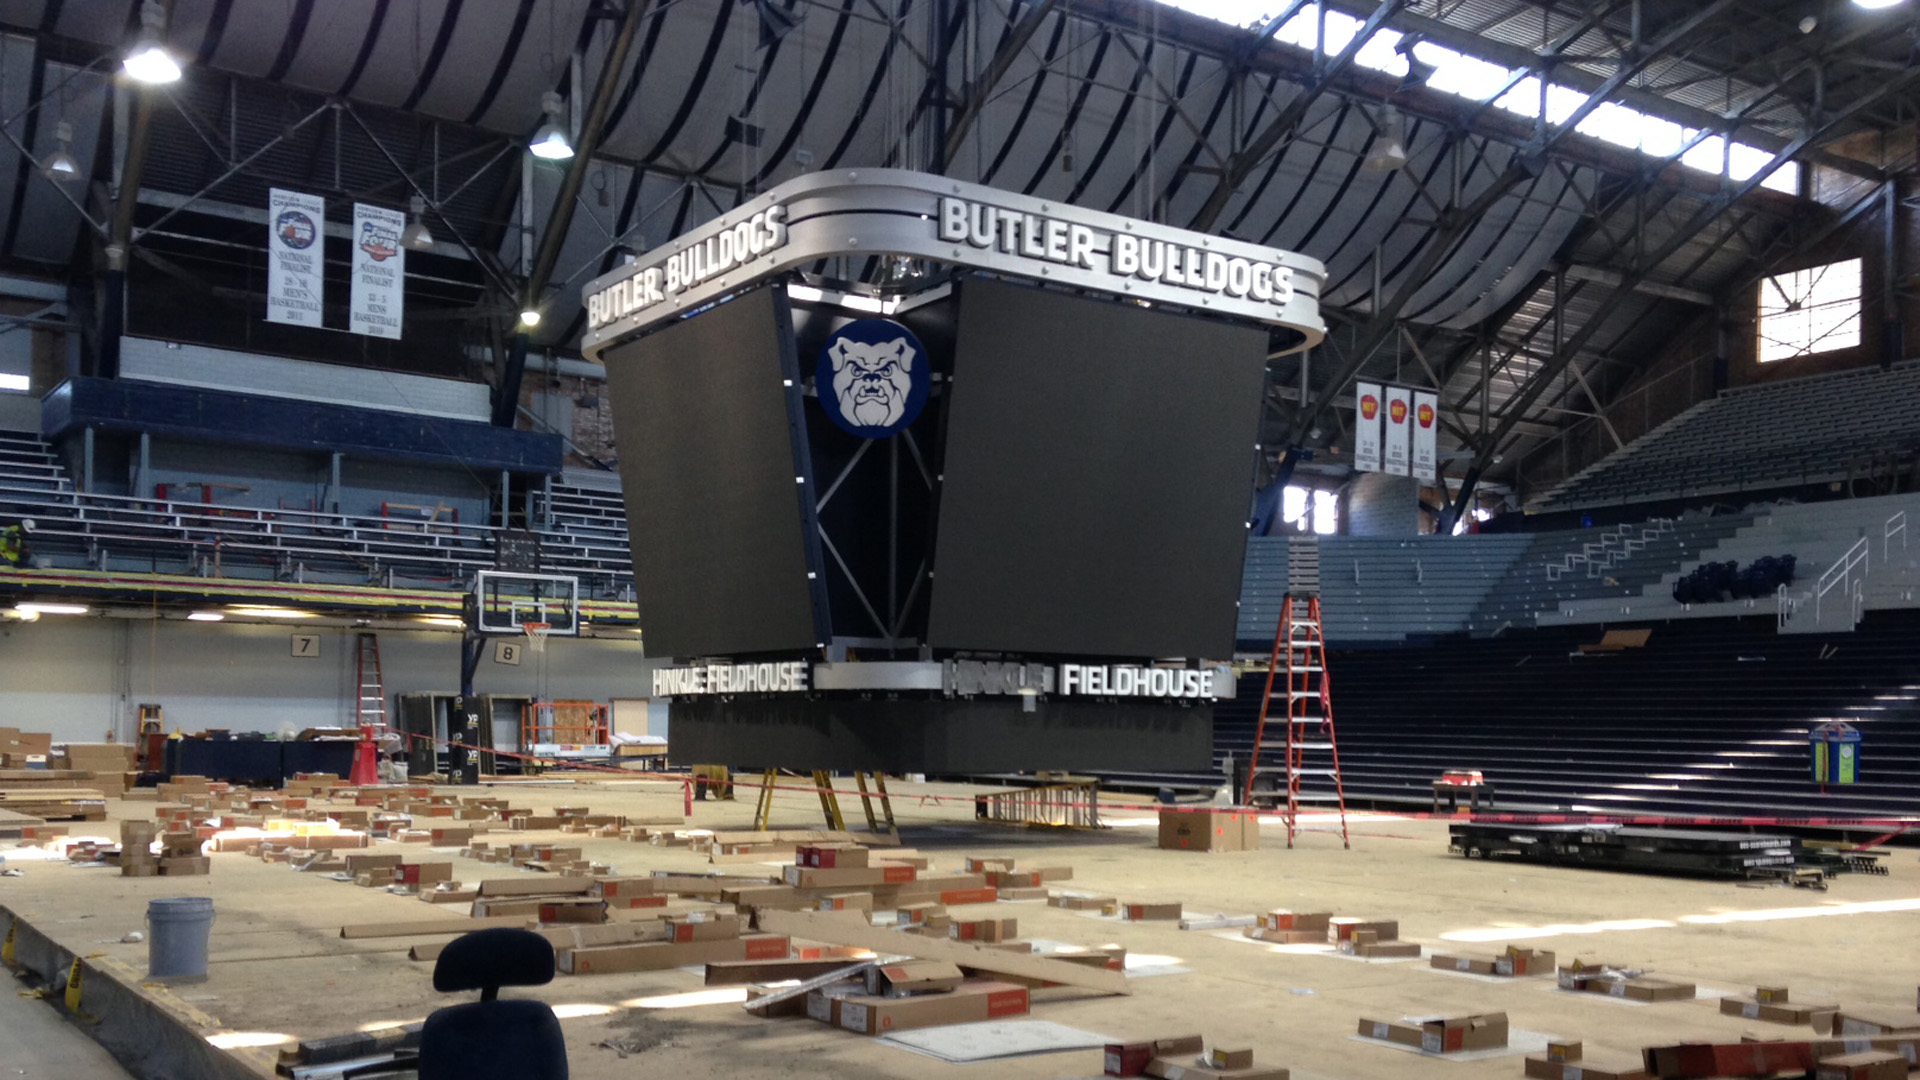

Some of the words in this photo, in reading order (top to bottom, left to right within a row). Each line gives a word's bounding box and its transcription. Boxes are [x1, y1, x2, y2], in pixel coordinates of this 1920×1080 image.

[273, 199, 321, 214] CHAMPIONS
[357, 211, 401, 226] CHAMPIONS
[279, 252, 313, 264] NATIONAL
[939, 197, 1094, 271] BUTLER
[1111, 233, 1294, 305] BULLDOGS
[280, 261, 312, 274] FINALIST
[361, 264, 395, 277] NATIONAL
[588, 267, 665, 329] BUTLER
[667, 204, 787, 294] BULLDOGS
[362, 274, 394, 288] FINALIST
[270, 296, 319, 312] BASKETBALL
[353, 311, 398, 327] BASKETBALL
[300, 638, 311, 652] 7
[503, 646, 513, 660] 8
[652, 667, 707, 697] HINKLE
[707, 661, 808, 694] FIELDHOUSE
[1060, 664, 1213, 699] FIELDHOUSE
